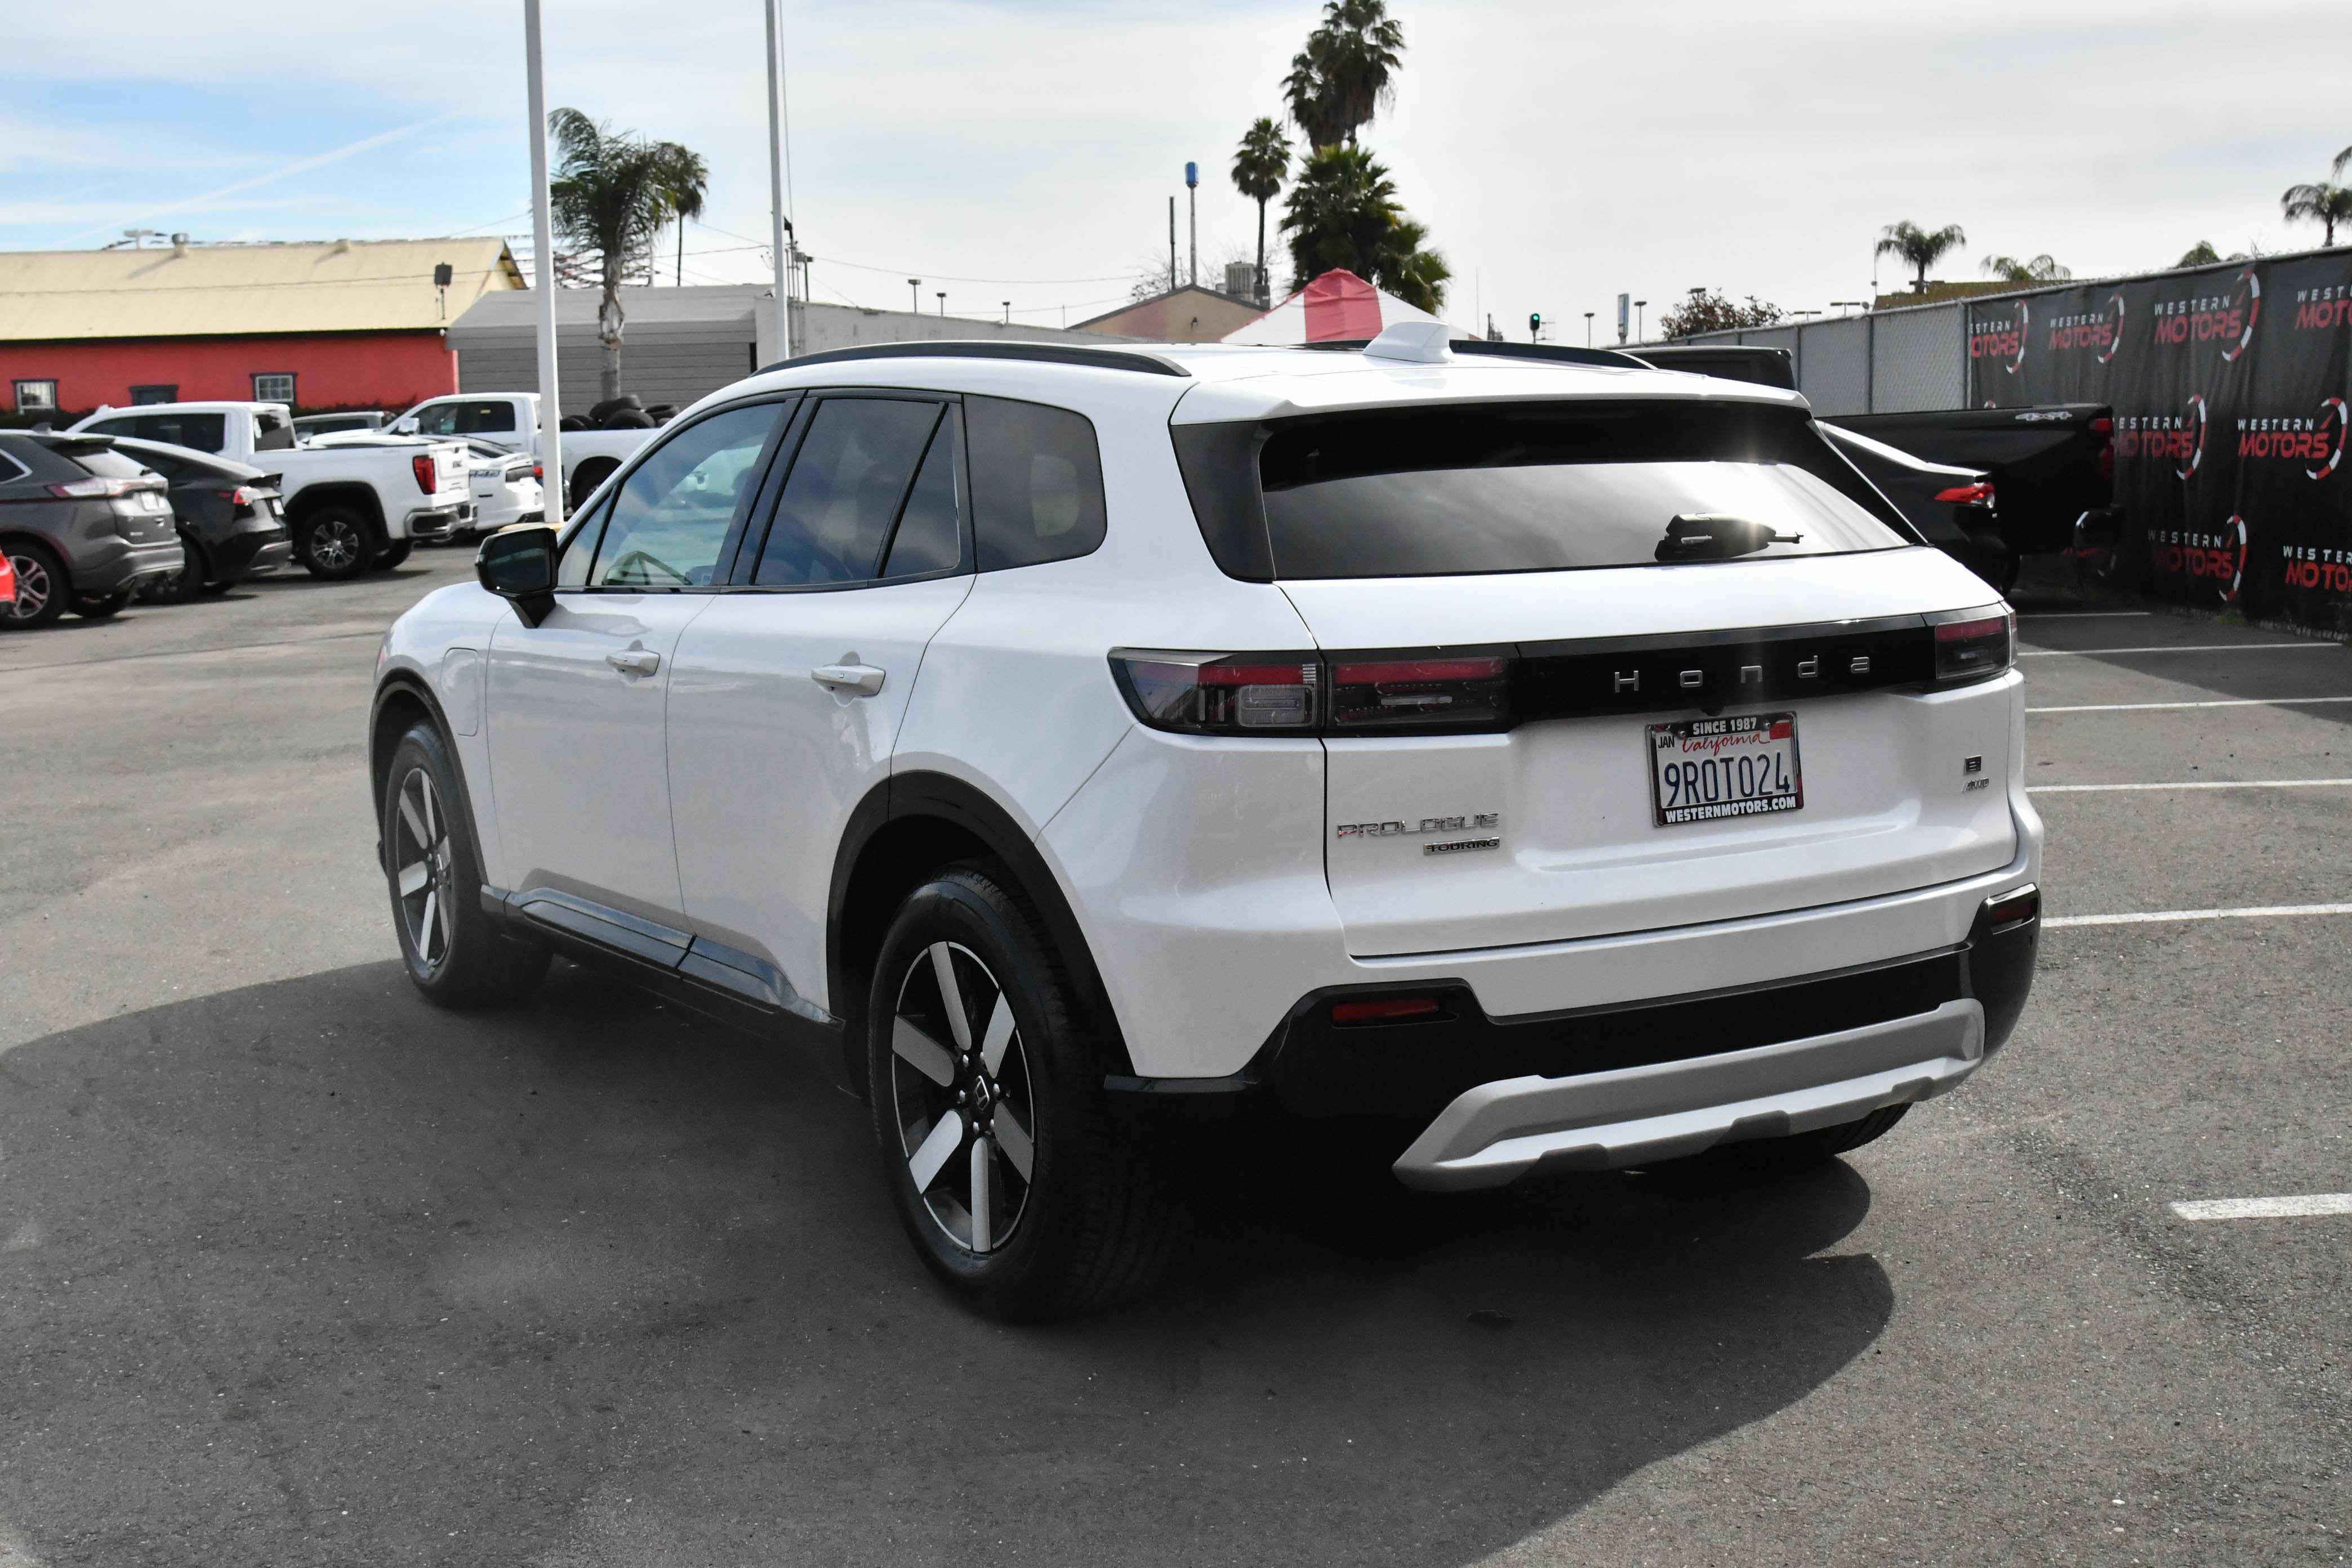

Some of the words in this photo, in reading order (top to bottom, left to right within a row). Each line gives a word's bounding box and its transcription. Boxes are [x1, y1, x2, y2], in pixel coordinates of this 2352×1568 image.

[2154, 295, 2230, 316] WESTERN
[2050, 313, 2103, 328] WESTERN
[2154, 309, 2242, 345] MOTORS
[2048, 324, 2112, 351] MOTORS
[2112, 416, 2182, 430] ESTERN
[2238, 418, 2314, 431] WESTERN
[2238, 431, 2329, 458] MOTORS
[2148, 528, 2222, 549] WESTERN
[2284, 559, 2352, 593] MOTO
[1693, 721, 1727, 735] SINCE
[1730, 717, 1757, 731] 1987
[1658, 736, 1675, 749] JAN
[1682, 733, 1771, 757] California
[1665, 796, 1796, 823] WESTERNMOTORS.COM
[1337, 812, 1499, 838] PROLOGUE
[1428, 839, 1498, 852] TOURING
